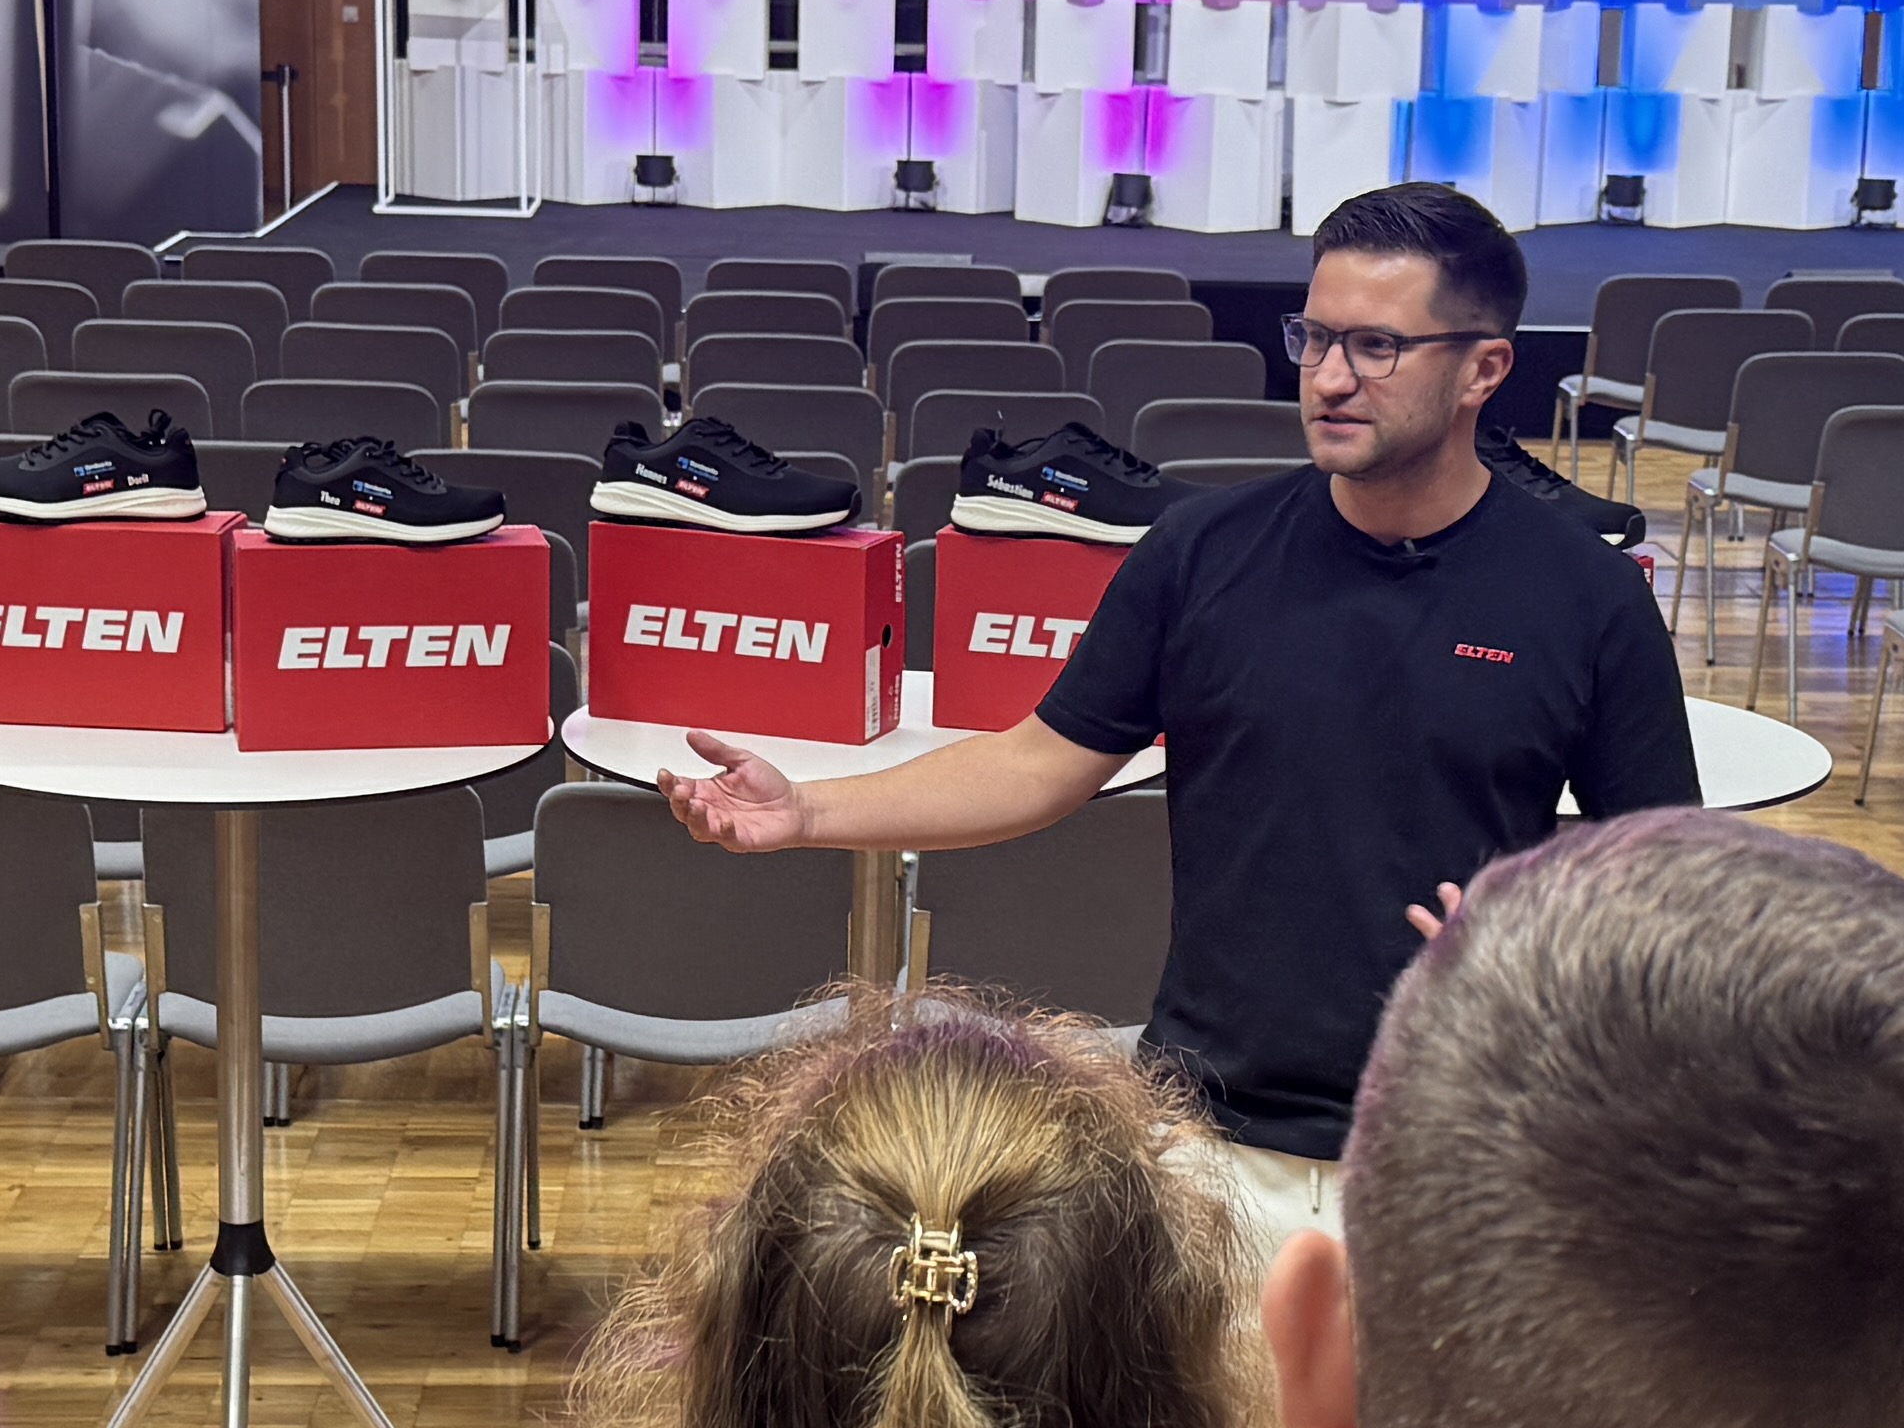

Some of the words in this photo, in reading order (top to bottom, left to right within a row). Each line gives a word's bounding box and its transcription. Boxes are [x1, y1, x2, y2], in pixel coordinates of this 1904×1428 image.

[987, 474, 1035, 500] Sebastian
[277, 624, 511, 670] ELTEN
[623, 604, 830, 663] ELTEN
[1454, 643, 1514, 664] ELTEN
